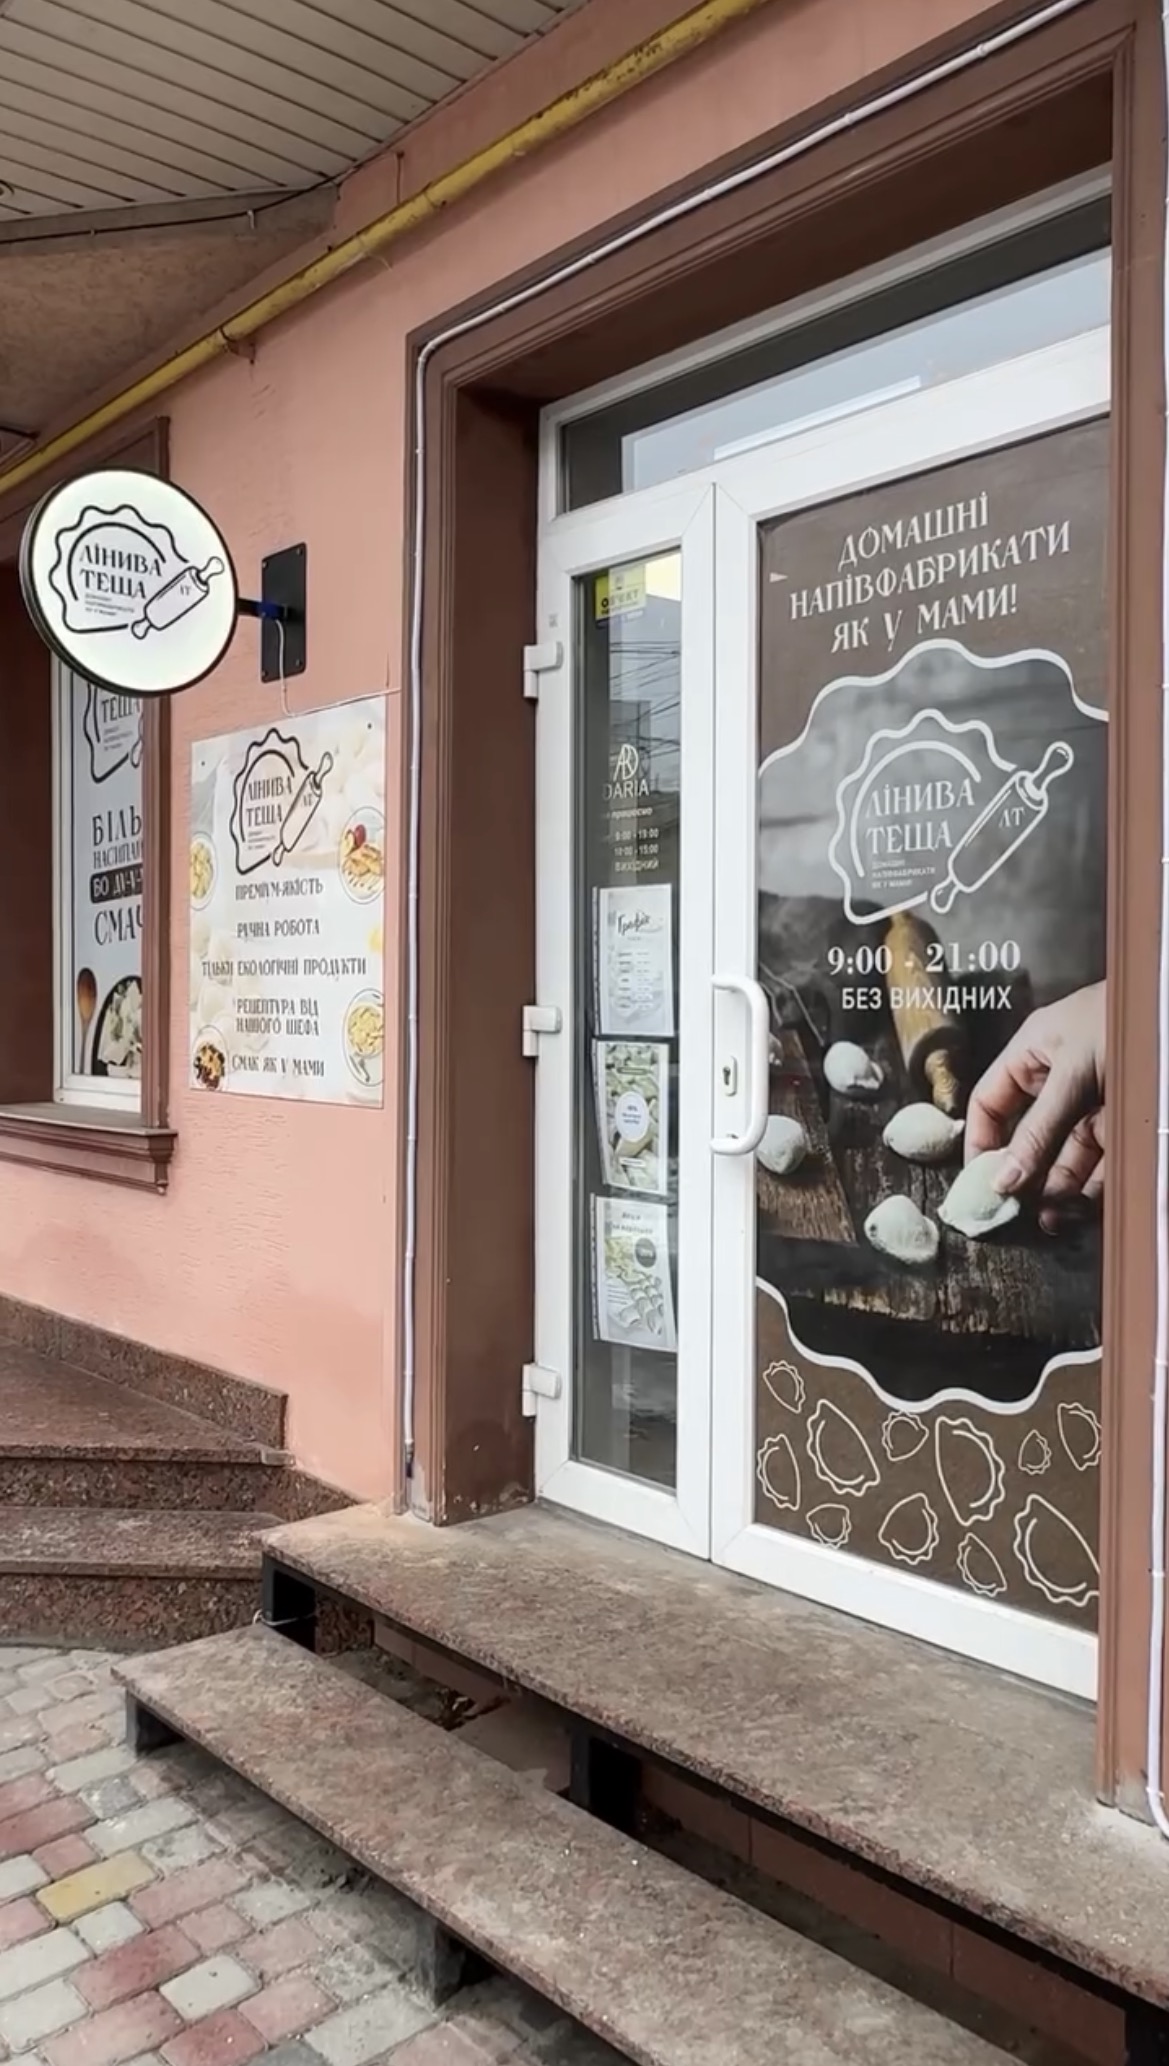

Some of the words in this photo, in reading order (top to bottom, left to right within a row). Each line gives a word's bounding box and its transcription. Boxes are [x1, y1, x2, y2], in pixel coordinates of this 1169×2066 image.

[837, 491, 989, 572] ДОМАШНІ
[79, 542, 162, 577] ЛІНИВА
[789, 520, 1072, 620] НАПІВФАБРИКАТИ
[80, 568, 146, 599] ТЕЩА
[831, 617, 869, 653] ЯК
[883, 609, 903, 652] У
[917, 583, 1018, 634] МАМИ!
[602, 778, 650, 801] DARIA
[864, 777, 976, 821] ЛІНИВА
[998, 807, 1026, 829] ЛТ
[866, 820, 953, 855] ТЕЩА
[274, 919, 319, 937] РОБОТА
[827, 946, 893, 975] 9:00
[925, 940, 1021, 972] 21:00
[842, 988, 882, 1010] БЕЗ
[890, 986, 1012, 1014] ВИХІДНИХ
